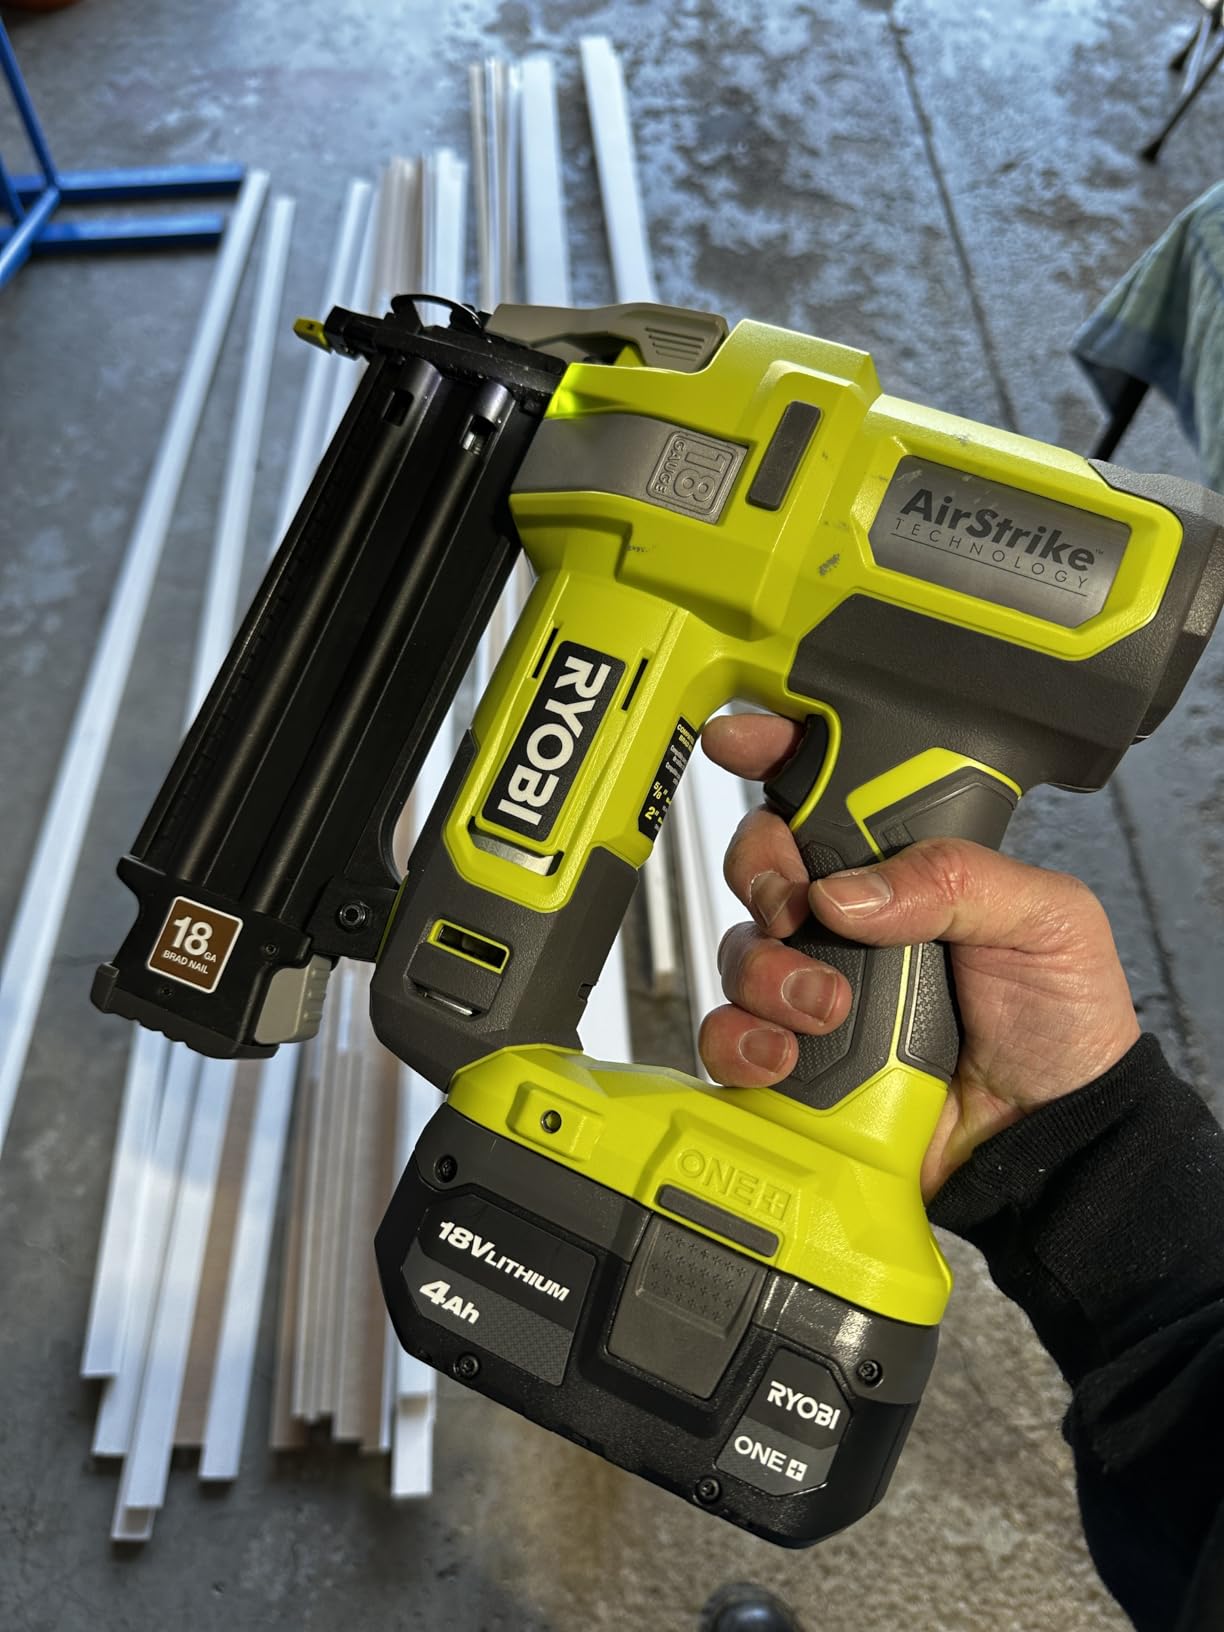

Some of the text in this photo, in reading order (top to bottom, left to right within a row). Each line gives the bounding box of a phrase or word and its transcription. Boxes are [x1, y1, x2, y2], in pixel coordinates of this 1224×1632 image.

[654, 439, 686, 494] GAUGE
[673, 452, 727, 503] 18
[894, 518, 1089, 590] TECHNOLOGY
[497, 655, 612, 826] RYOBI
[162, 949, 209, 975] BRAD NAIL
[173, 916, 218, 963] 18 GA
[419, 1279, 481, 1325] 4Ah
[767, 1380, 841, 1430] RYOBI
